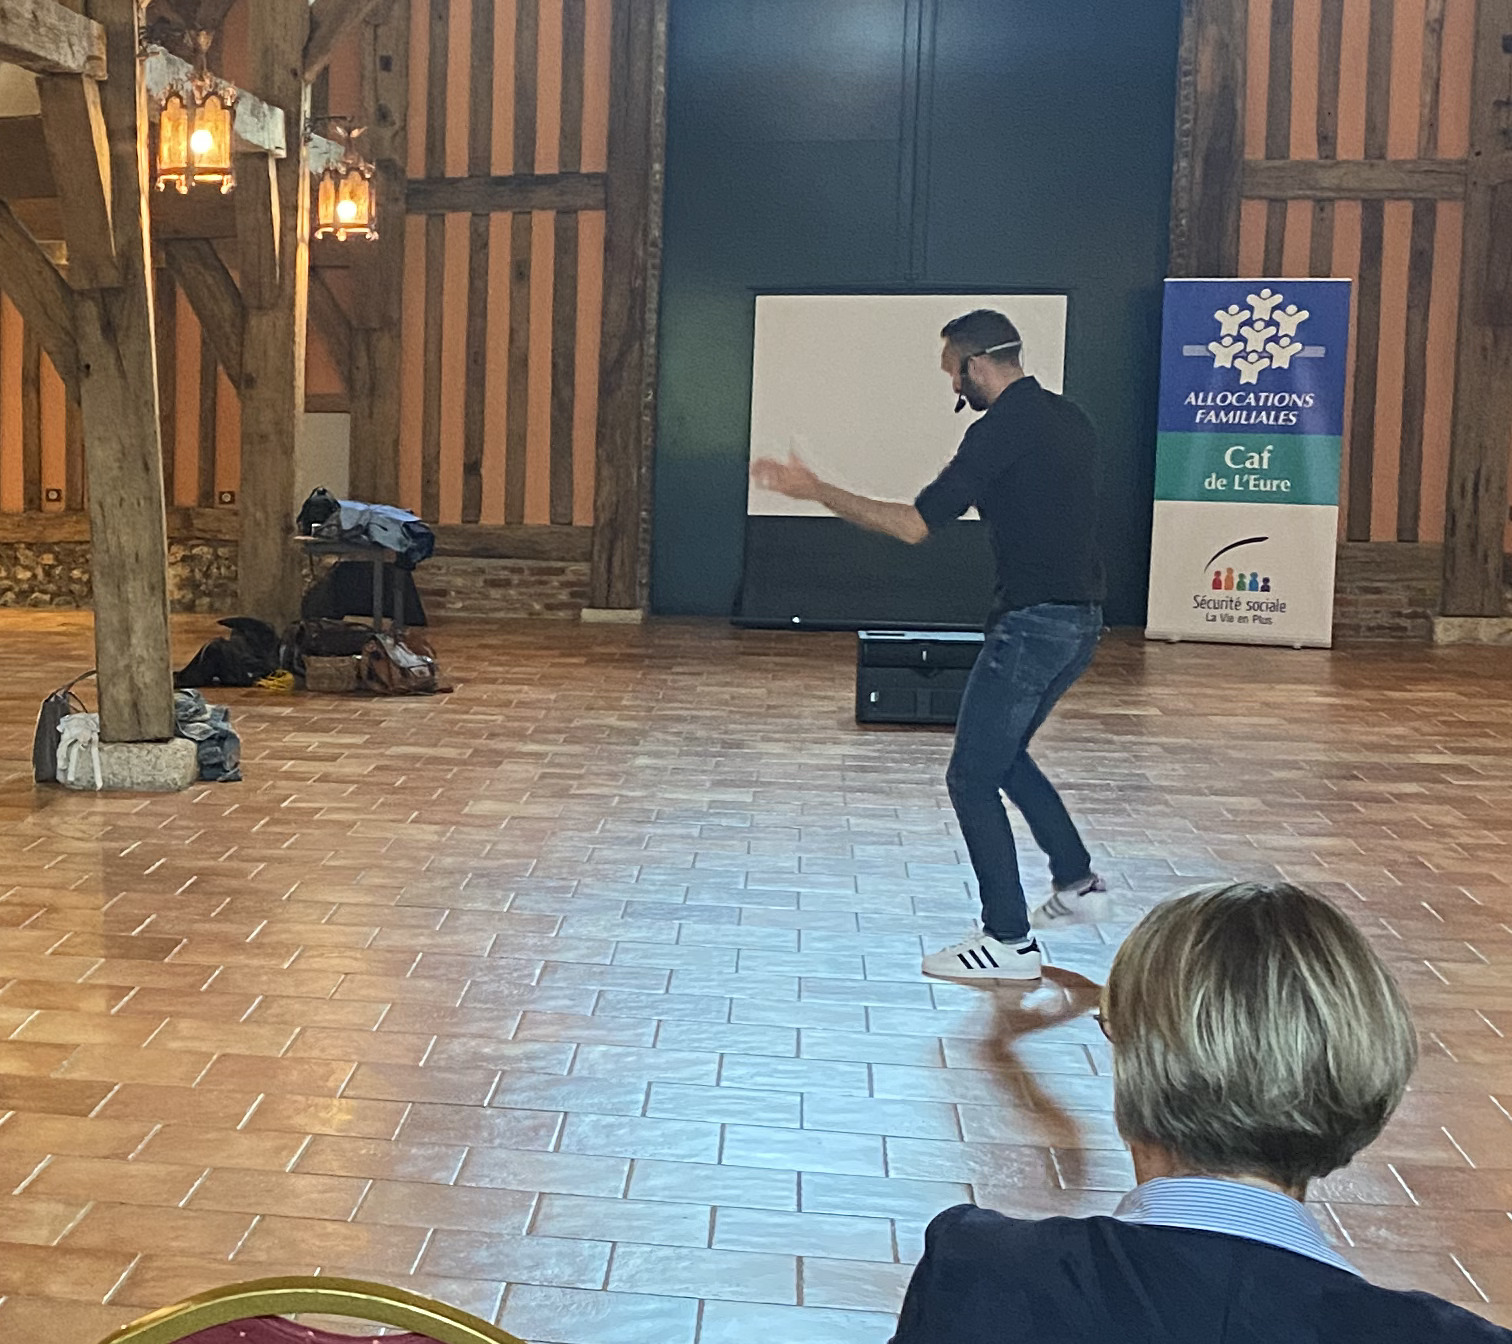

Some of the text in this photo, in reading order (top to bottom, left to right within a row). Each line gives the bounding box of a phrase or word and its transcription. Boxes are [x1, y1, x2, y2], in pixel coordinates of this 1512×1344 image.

[1184, 391, 1315, 407] ALLOCATIONS
[1195, 409, 1298, 426] FAMILIALES
[1224, 445, 1274, 469] Caf
[1204, 472, 1291, 492] de L'Eure
[1192, 594, 1287, 613] Sécurité sociale
[1205, 612, 1273, 625] La Vie en Plus
